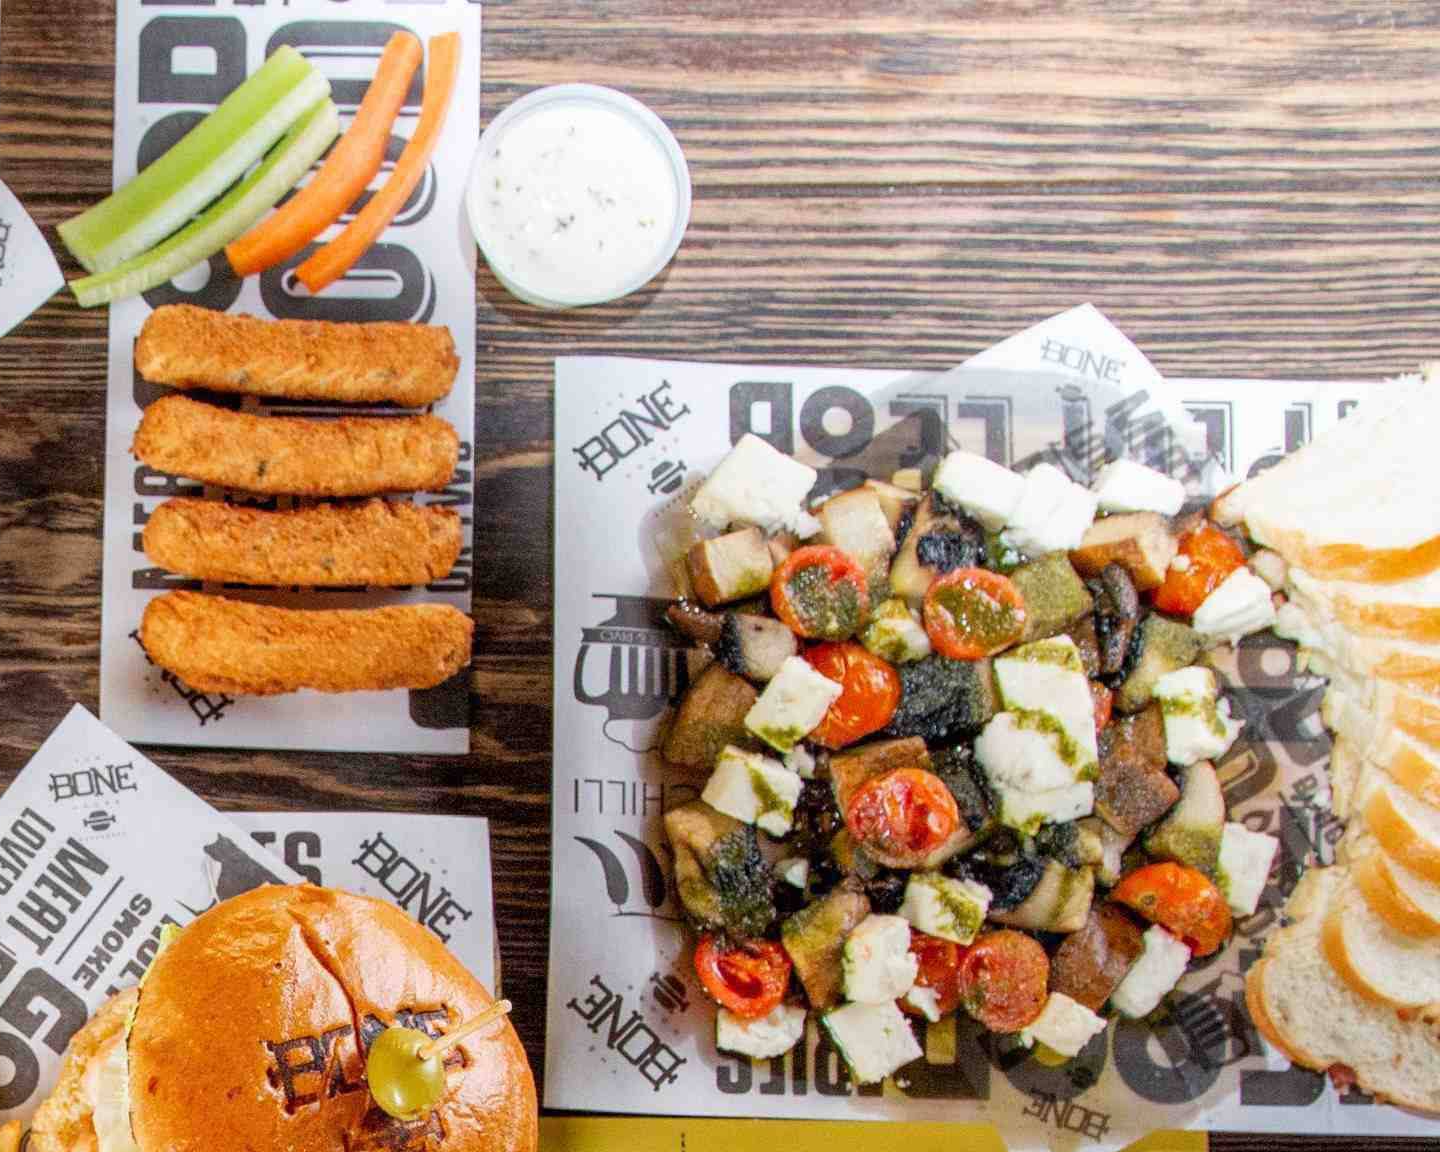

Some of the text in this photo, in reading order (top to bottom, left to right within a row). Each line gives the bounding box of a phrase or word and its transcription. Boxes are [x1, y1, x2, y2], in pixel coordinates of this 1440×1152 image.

[1041, 336, 1127, 384] BONE
[572, 379, 691, 482] BONE
[48, 762, 138, 803] BONE
[7, 838, 110, 957] MEAT
[352, 831, 473, 945] BONE
[72, 893, 153, 991] SMOKE
[567, 975, 687, 1092] BONE
[1023, 1087, 1111, 1143] BONE
